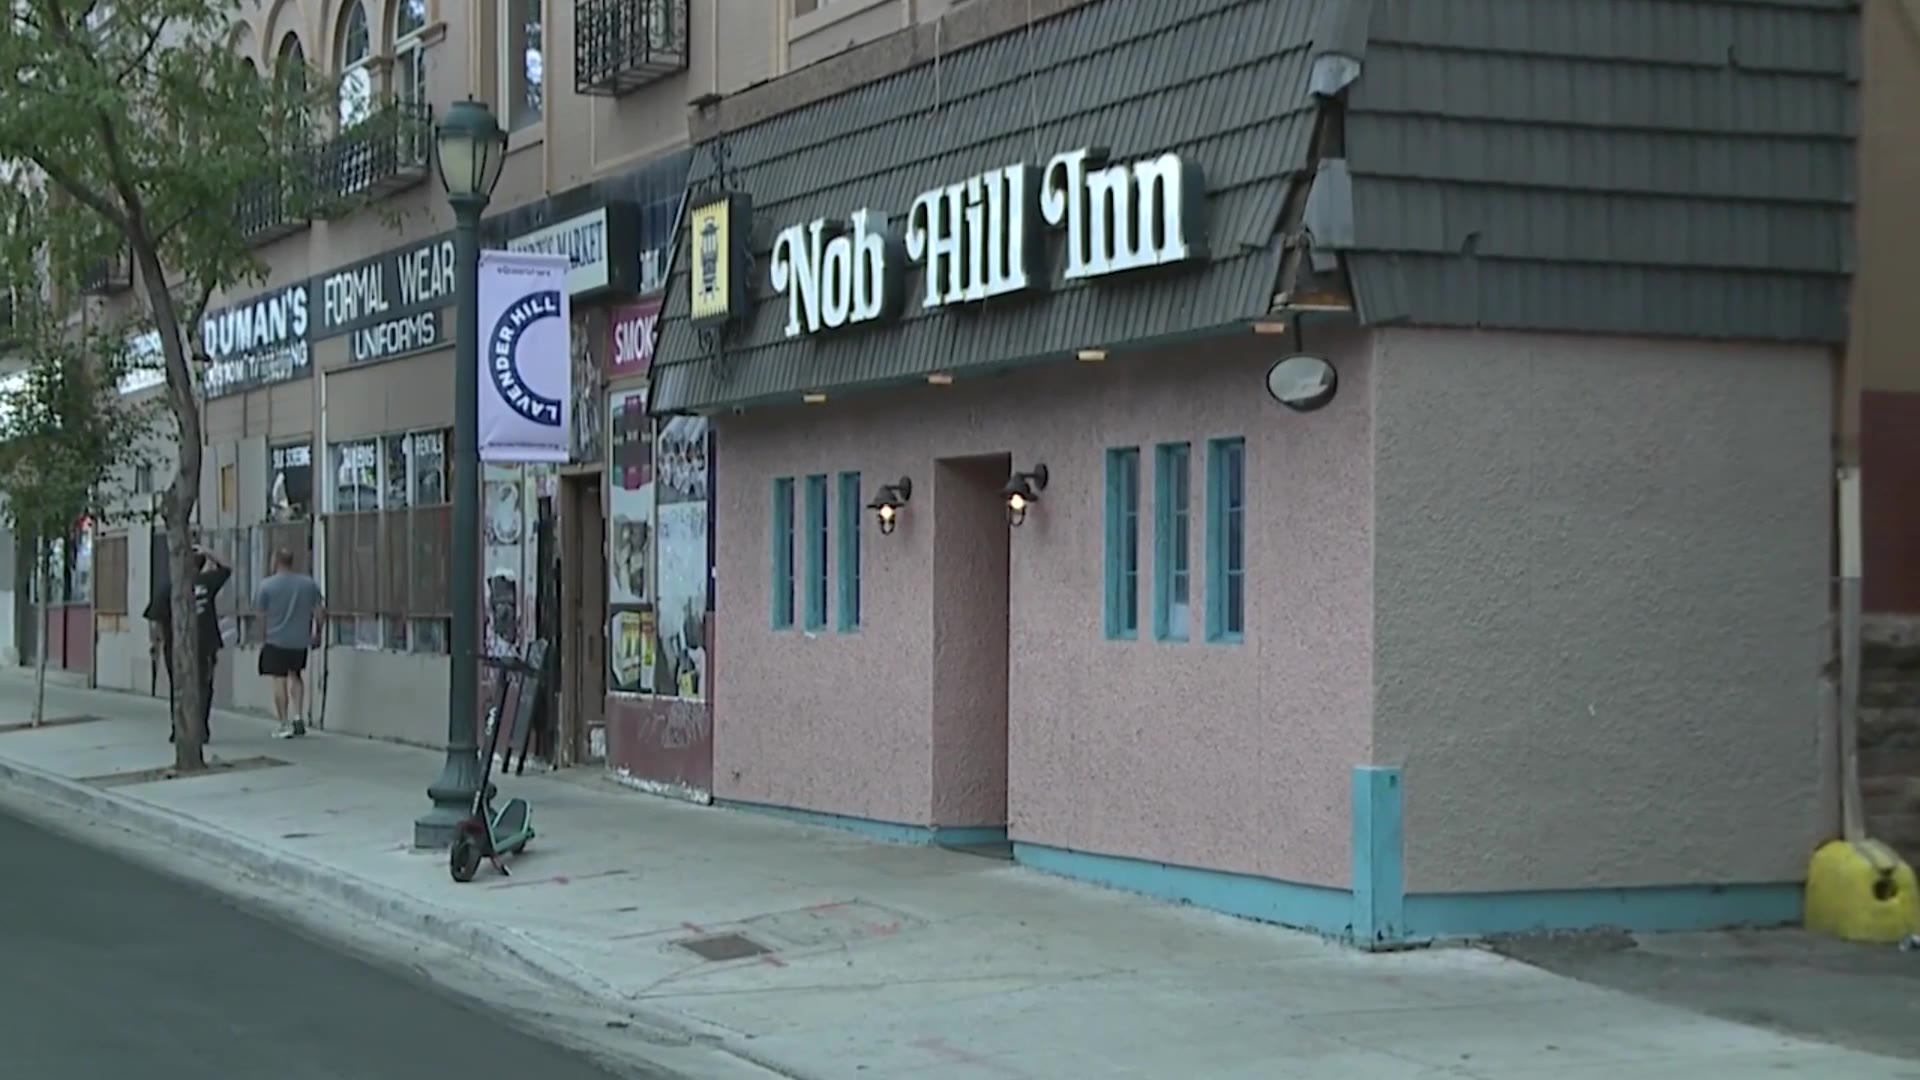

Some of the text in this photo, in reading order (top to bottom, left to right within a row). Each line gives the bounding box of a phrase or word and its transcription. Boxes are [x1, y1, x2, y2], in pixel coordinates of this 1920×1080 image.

[324, 239, 456, 328] FORMAL WEAR
[771, 147, 1190, 338] Nob Hill Inn
[355, 311, 436, 360] UNIFORMS
[510, 296, 557, 326] HILL
[495, 325, 558, 421] LAVENDER
